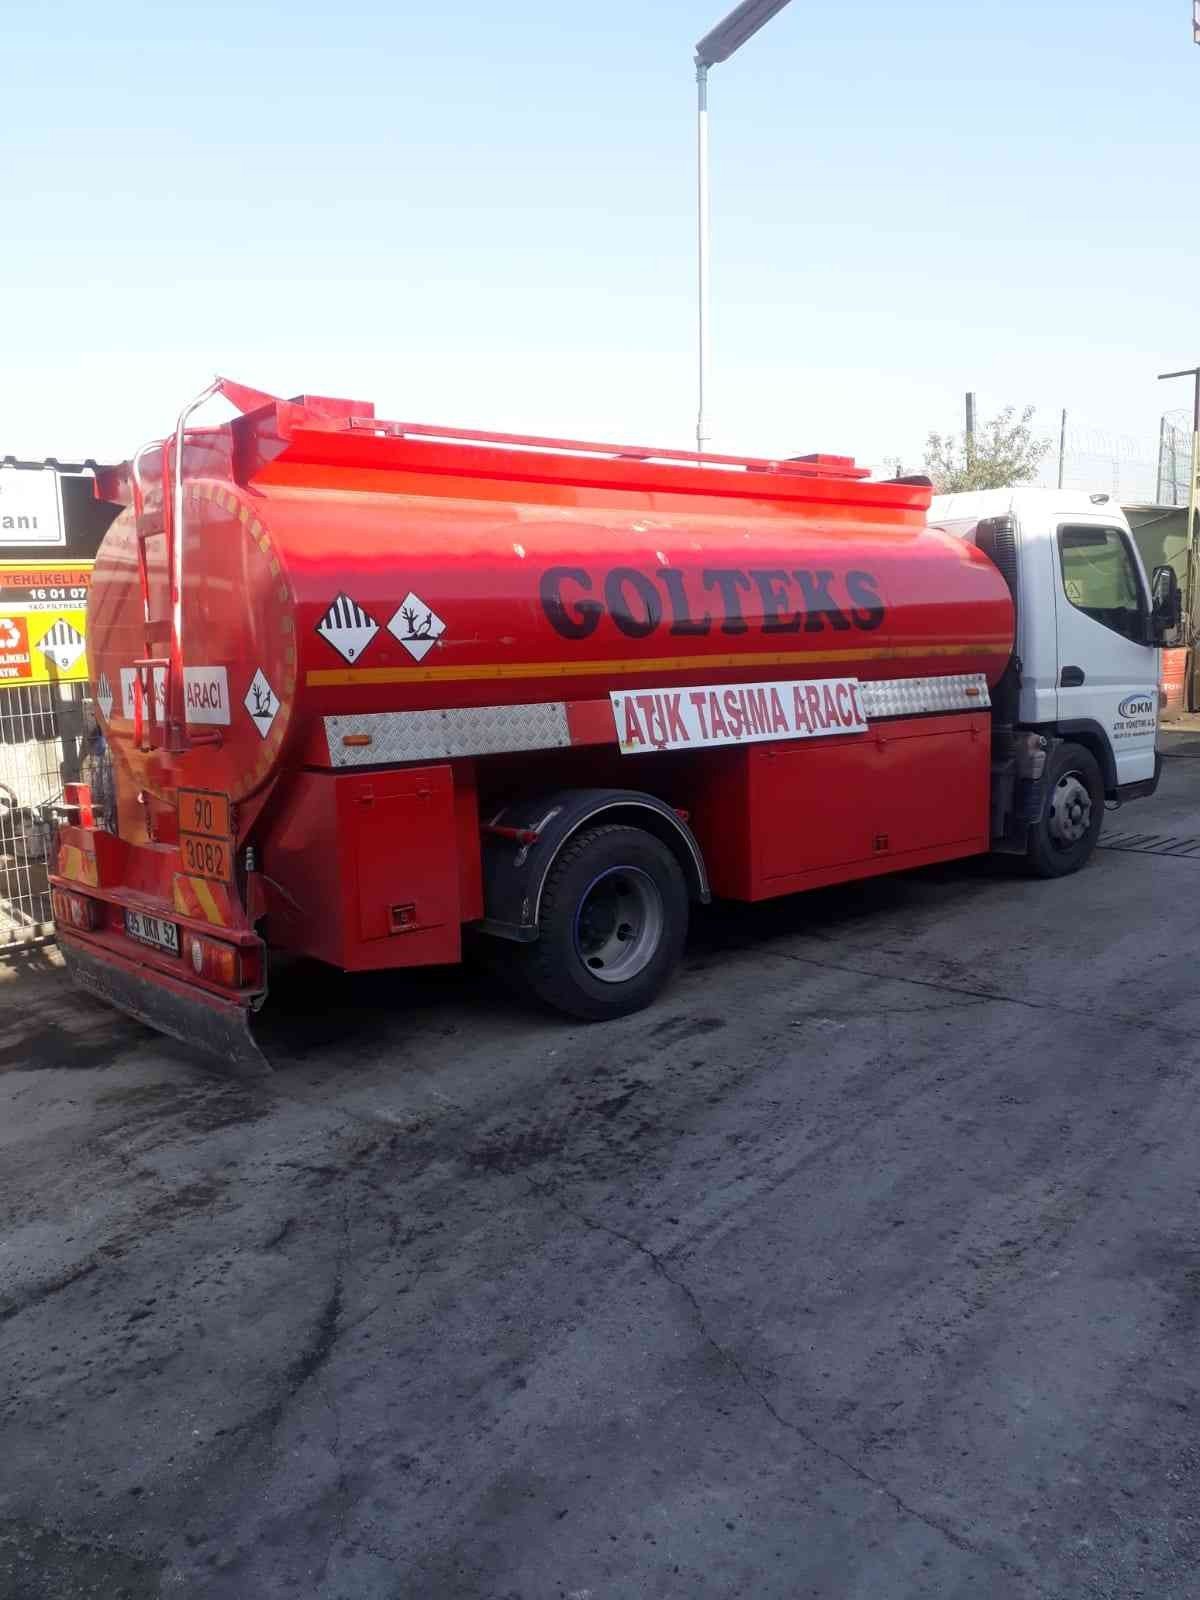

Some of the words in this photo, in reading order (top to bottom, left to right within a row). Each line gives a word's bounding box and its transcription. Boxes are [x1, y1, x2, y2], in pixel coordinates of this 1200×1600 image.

[30, 588, 46, 600] 16
[50, 588, 66, 599] 01
[70, 588, 87, 598] 07
[539, 566, 885, 640] GOLTEKS
[62, 657, 69, 667] 9
[348, 648, 355, 657] 9
[187, 681, 223, 709] ARACI
[1130, 701, 1152, 714] DKM
[195, 797, 212, 830] 90
[186, 839, 225, 876] 3082
[164, 921, 176, 947] 52
